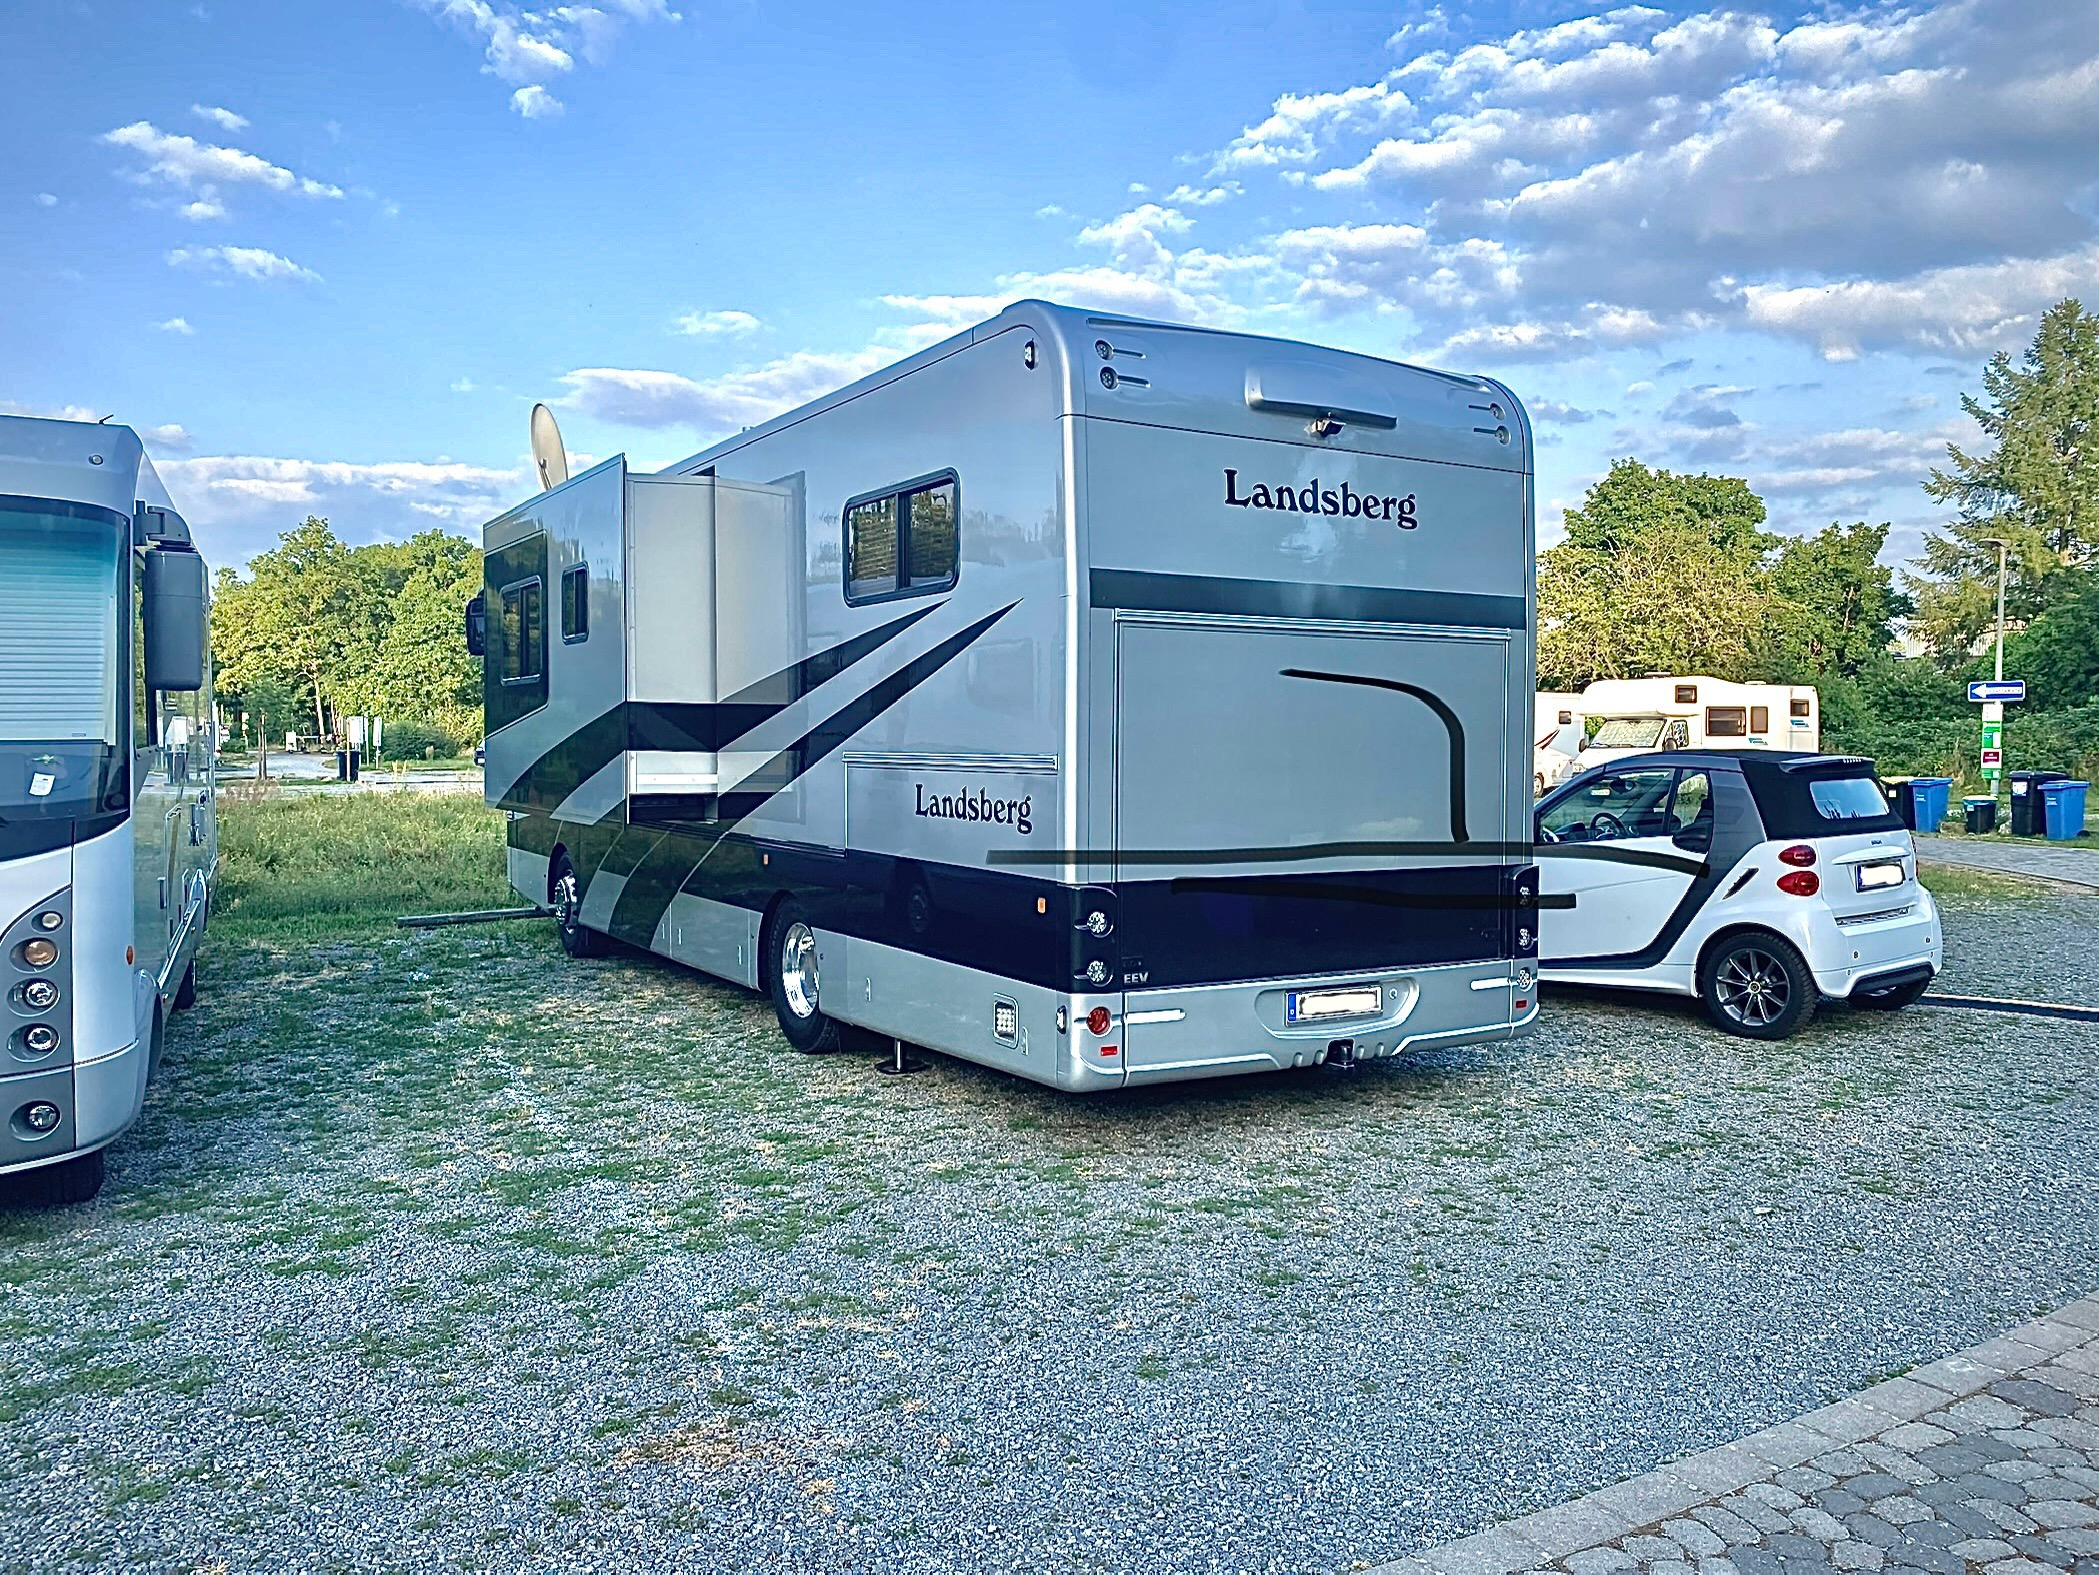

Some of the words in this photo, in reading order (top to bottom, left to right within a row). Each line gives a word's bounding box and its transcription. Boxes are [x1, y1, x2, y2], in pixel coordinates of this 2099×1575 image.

[1223, 468, 1418, 530] Landsberg
[915, 783, 1033, 835] Landsberg
[1124, 972, 1149, 983] EEV
